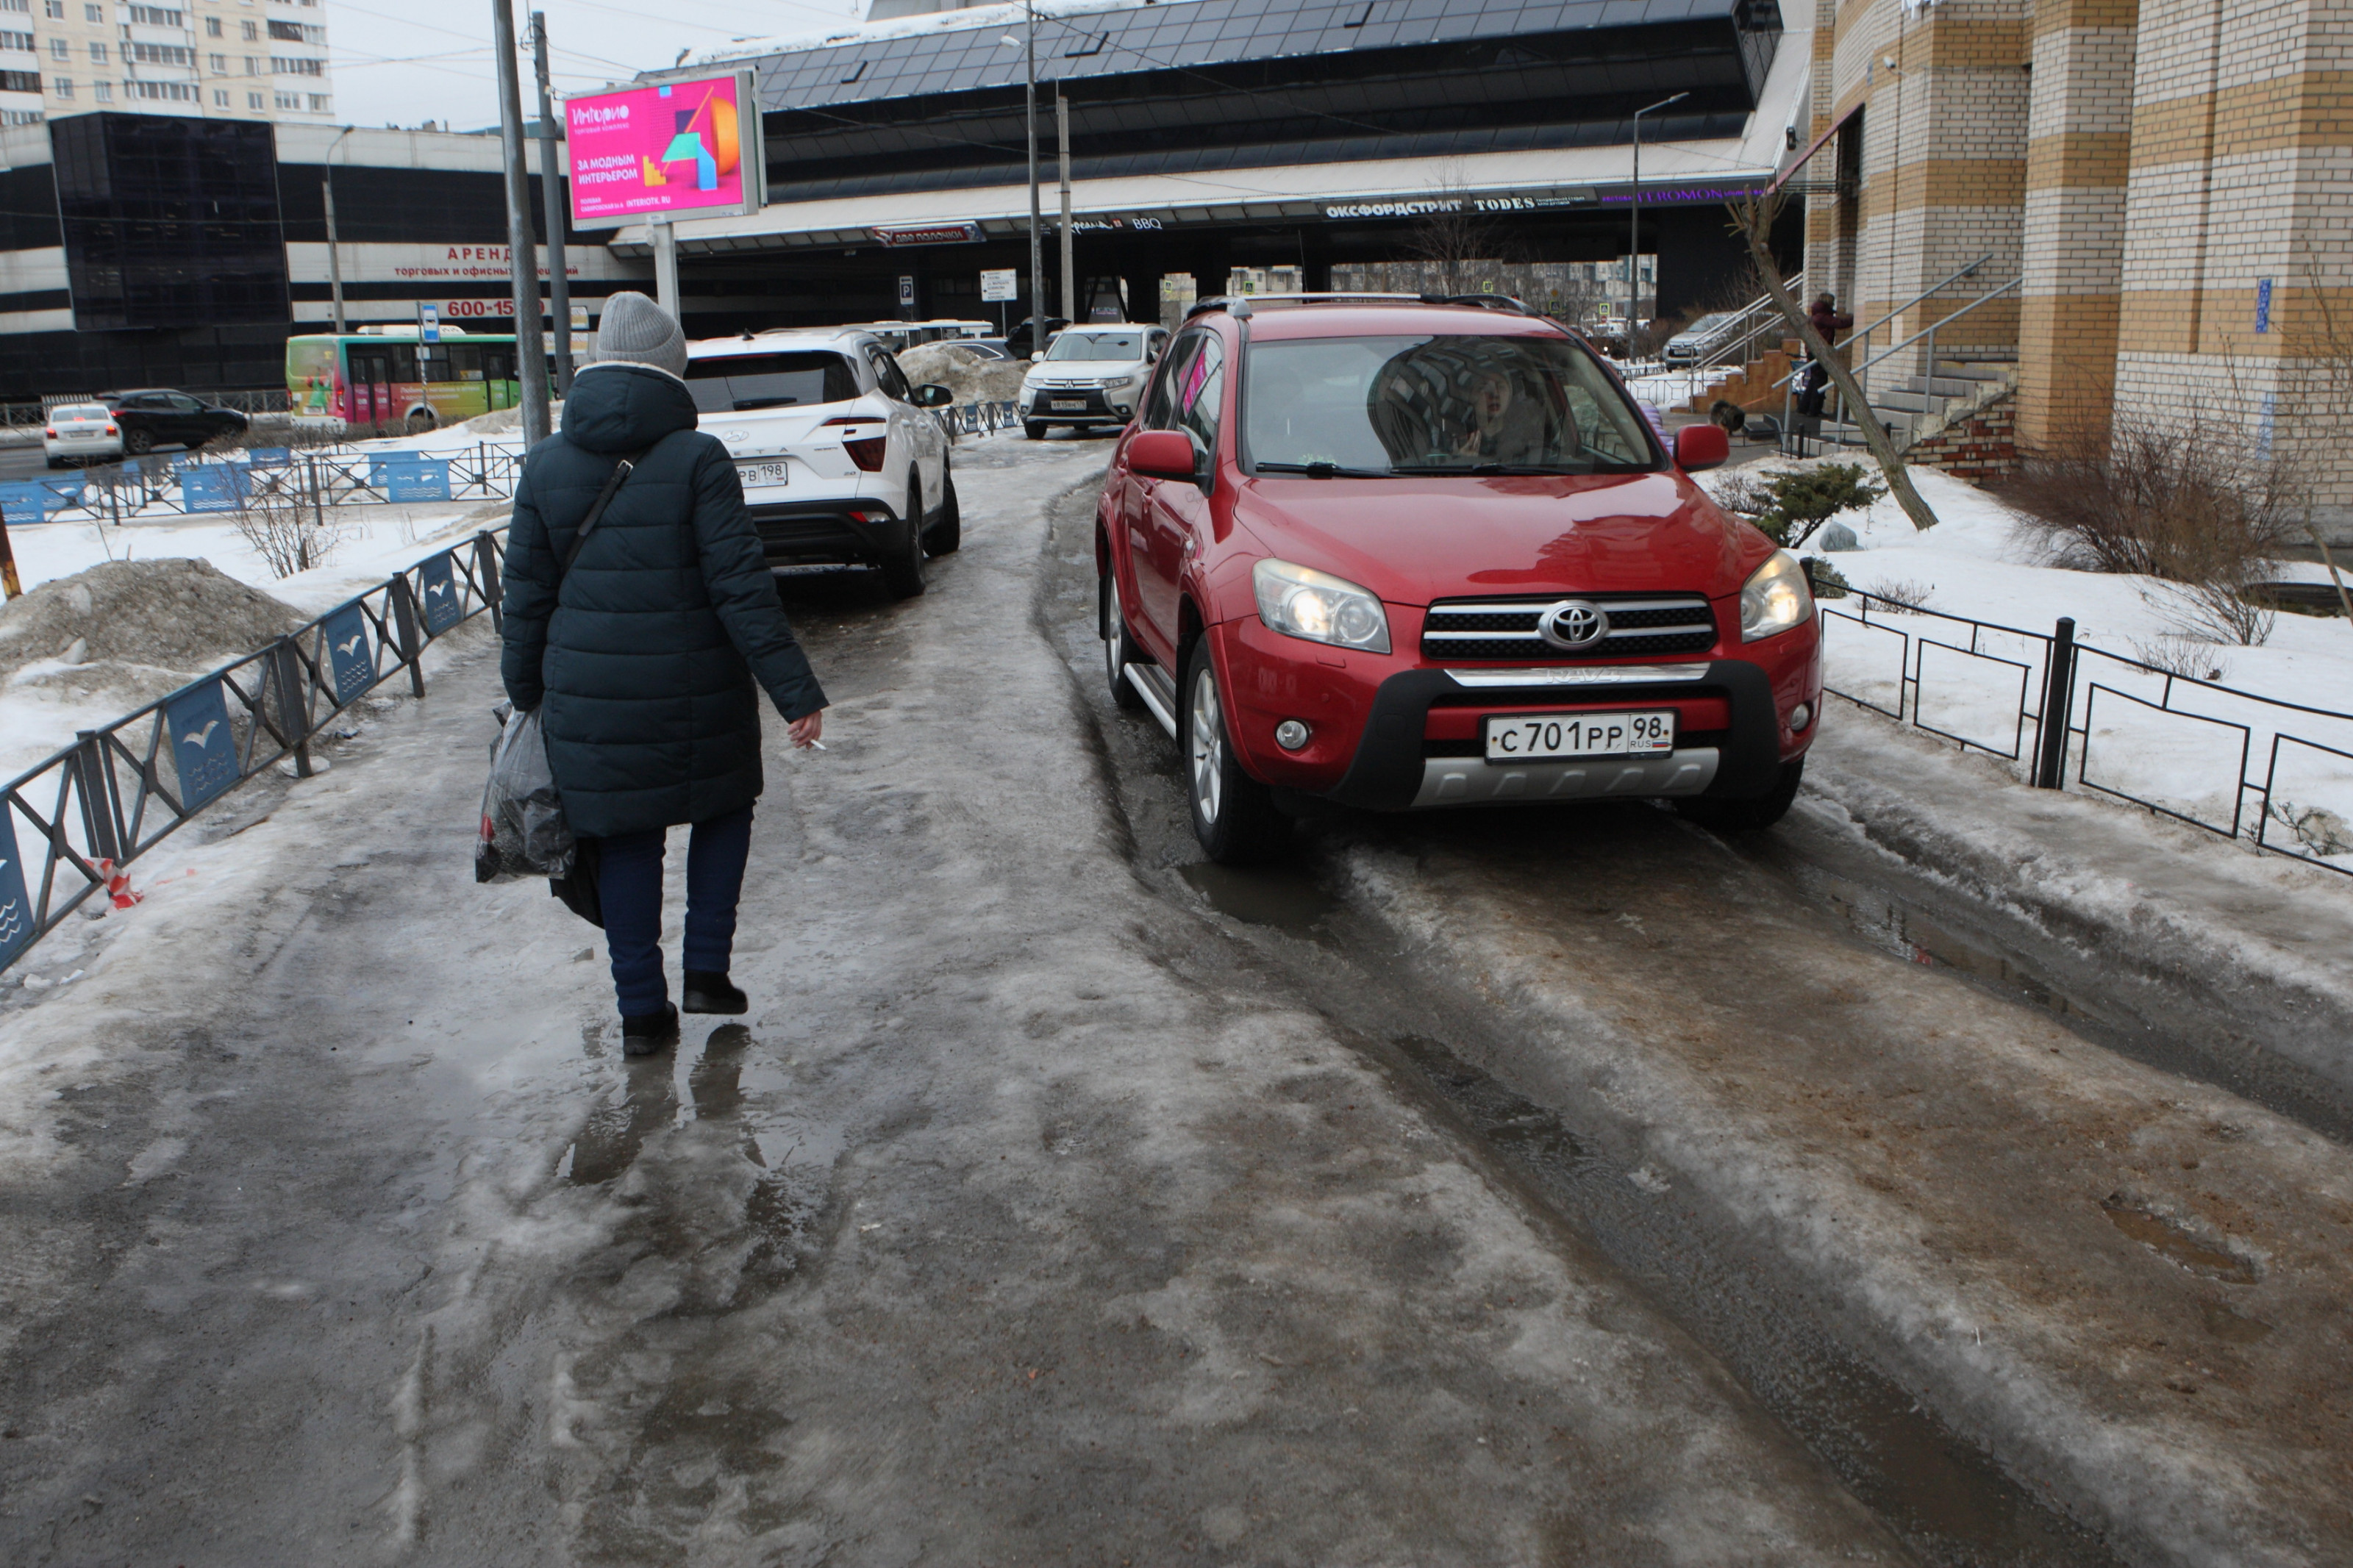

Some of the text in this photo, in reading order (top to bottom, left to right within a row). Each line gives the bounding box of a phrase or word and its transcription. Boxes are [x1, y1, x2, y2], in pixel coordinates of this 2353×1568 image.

[577, 154, 635, 171] ЗА МОДНЫМ
[578, 168, 638, 185] ИНТЕРЬЕРОМ
[1638, 188, 1724, 203] FEROMON
[1326, 199, 1463, 218] ОКСФОРДСТРИТ
[1473, 196, 1535, 212] TODES
[1132, 218, 1163, 230] BBQ
[395, 267, 449, 278] торговых
[760, 465, 782, 476] 198
[1633, 717, 1662, 740] 98
[1630, 740, 1652, 748] RUS
